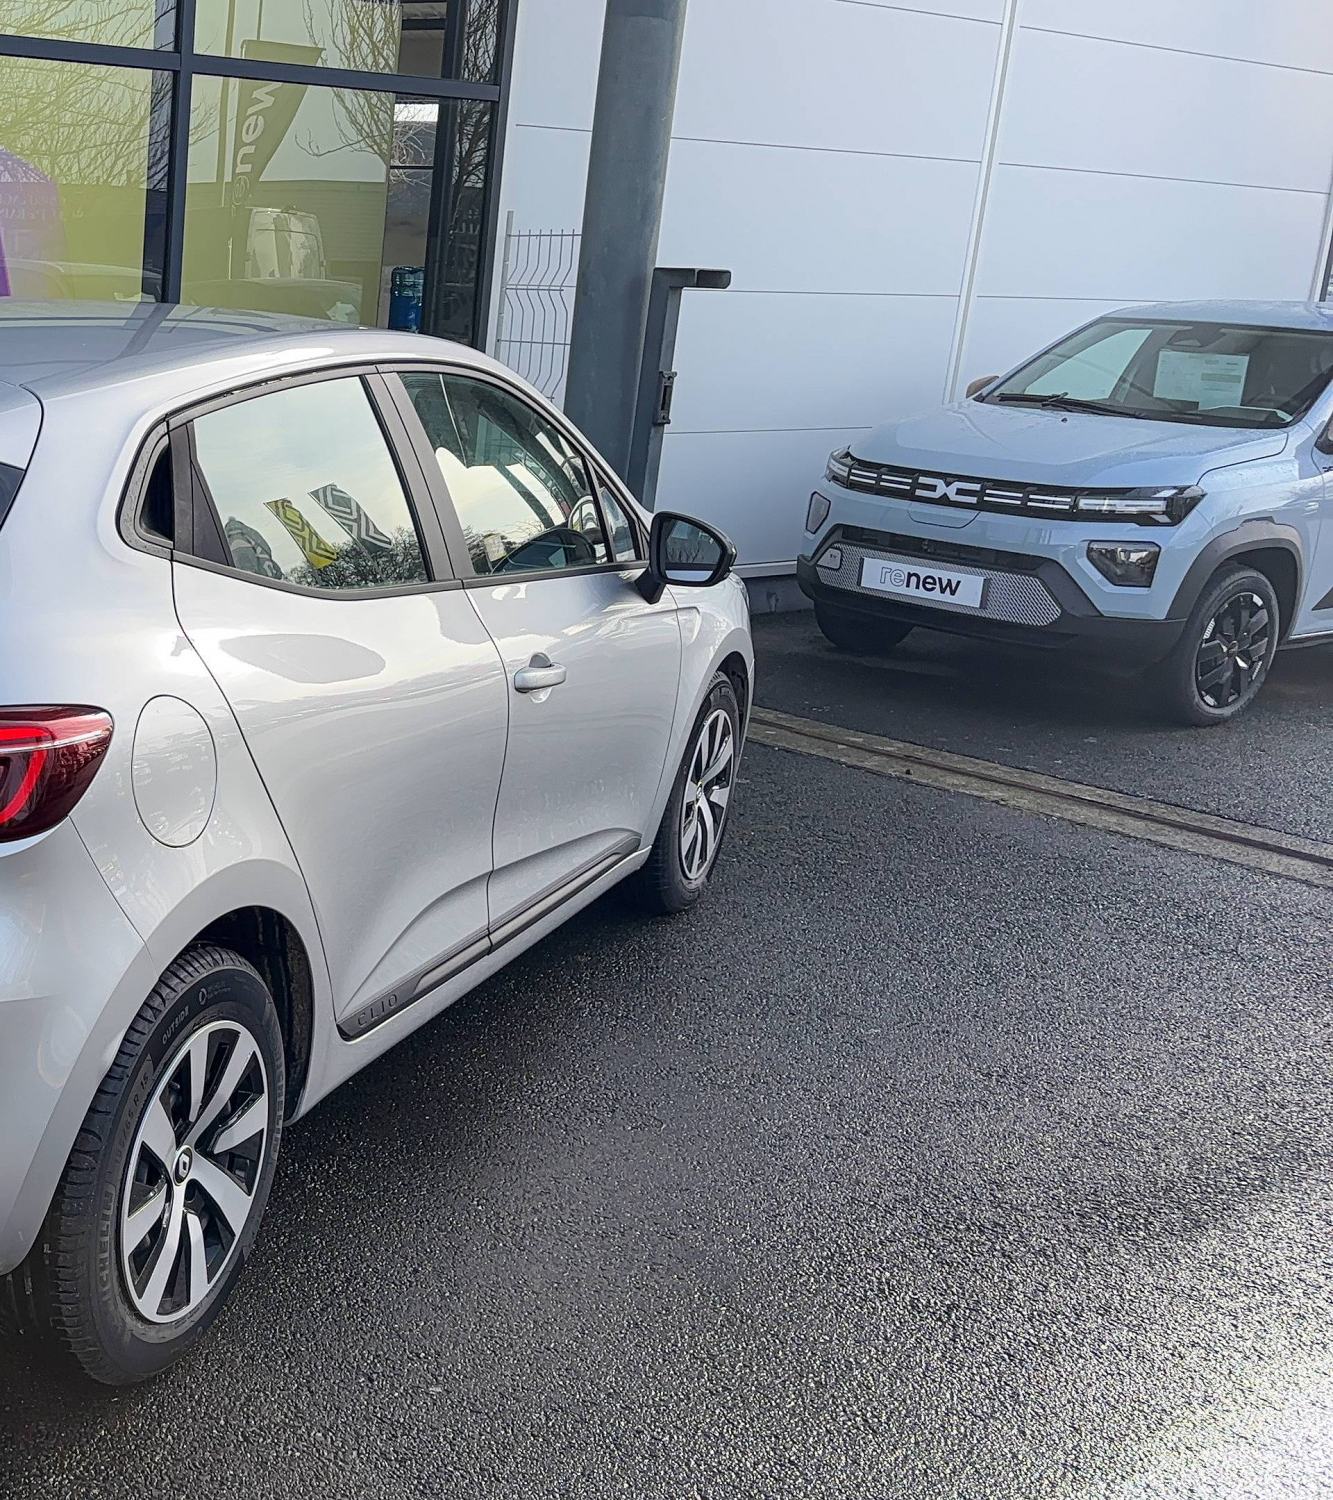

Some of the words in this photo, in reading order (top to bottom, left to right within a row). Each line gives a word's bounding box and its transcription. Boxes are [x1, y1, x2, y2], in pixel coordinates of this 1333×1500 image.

[880, 566, 961, 597] renew
[162, 1005, 189, 1045] OUTSIDE
[357, 993, 398, 1027] CLIO
